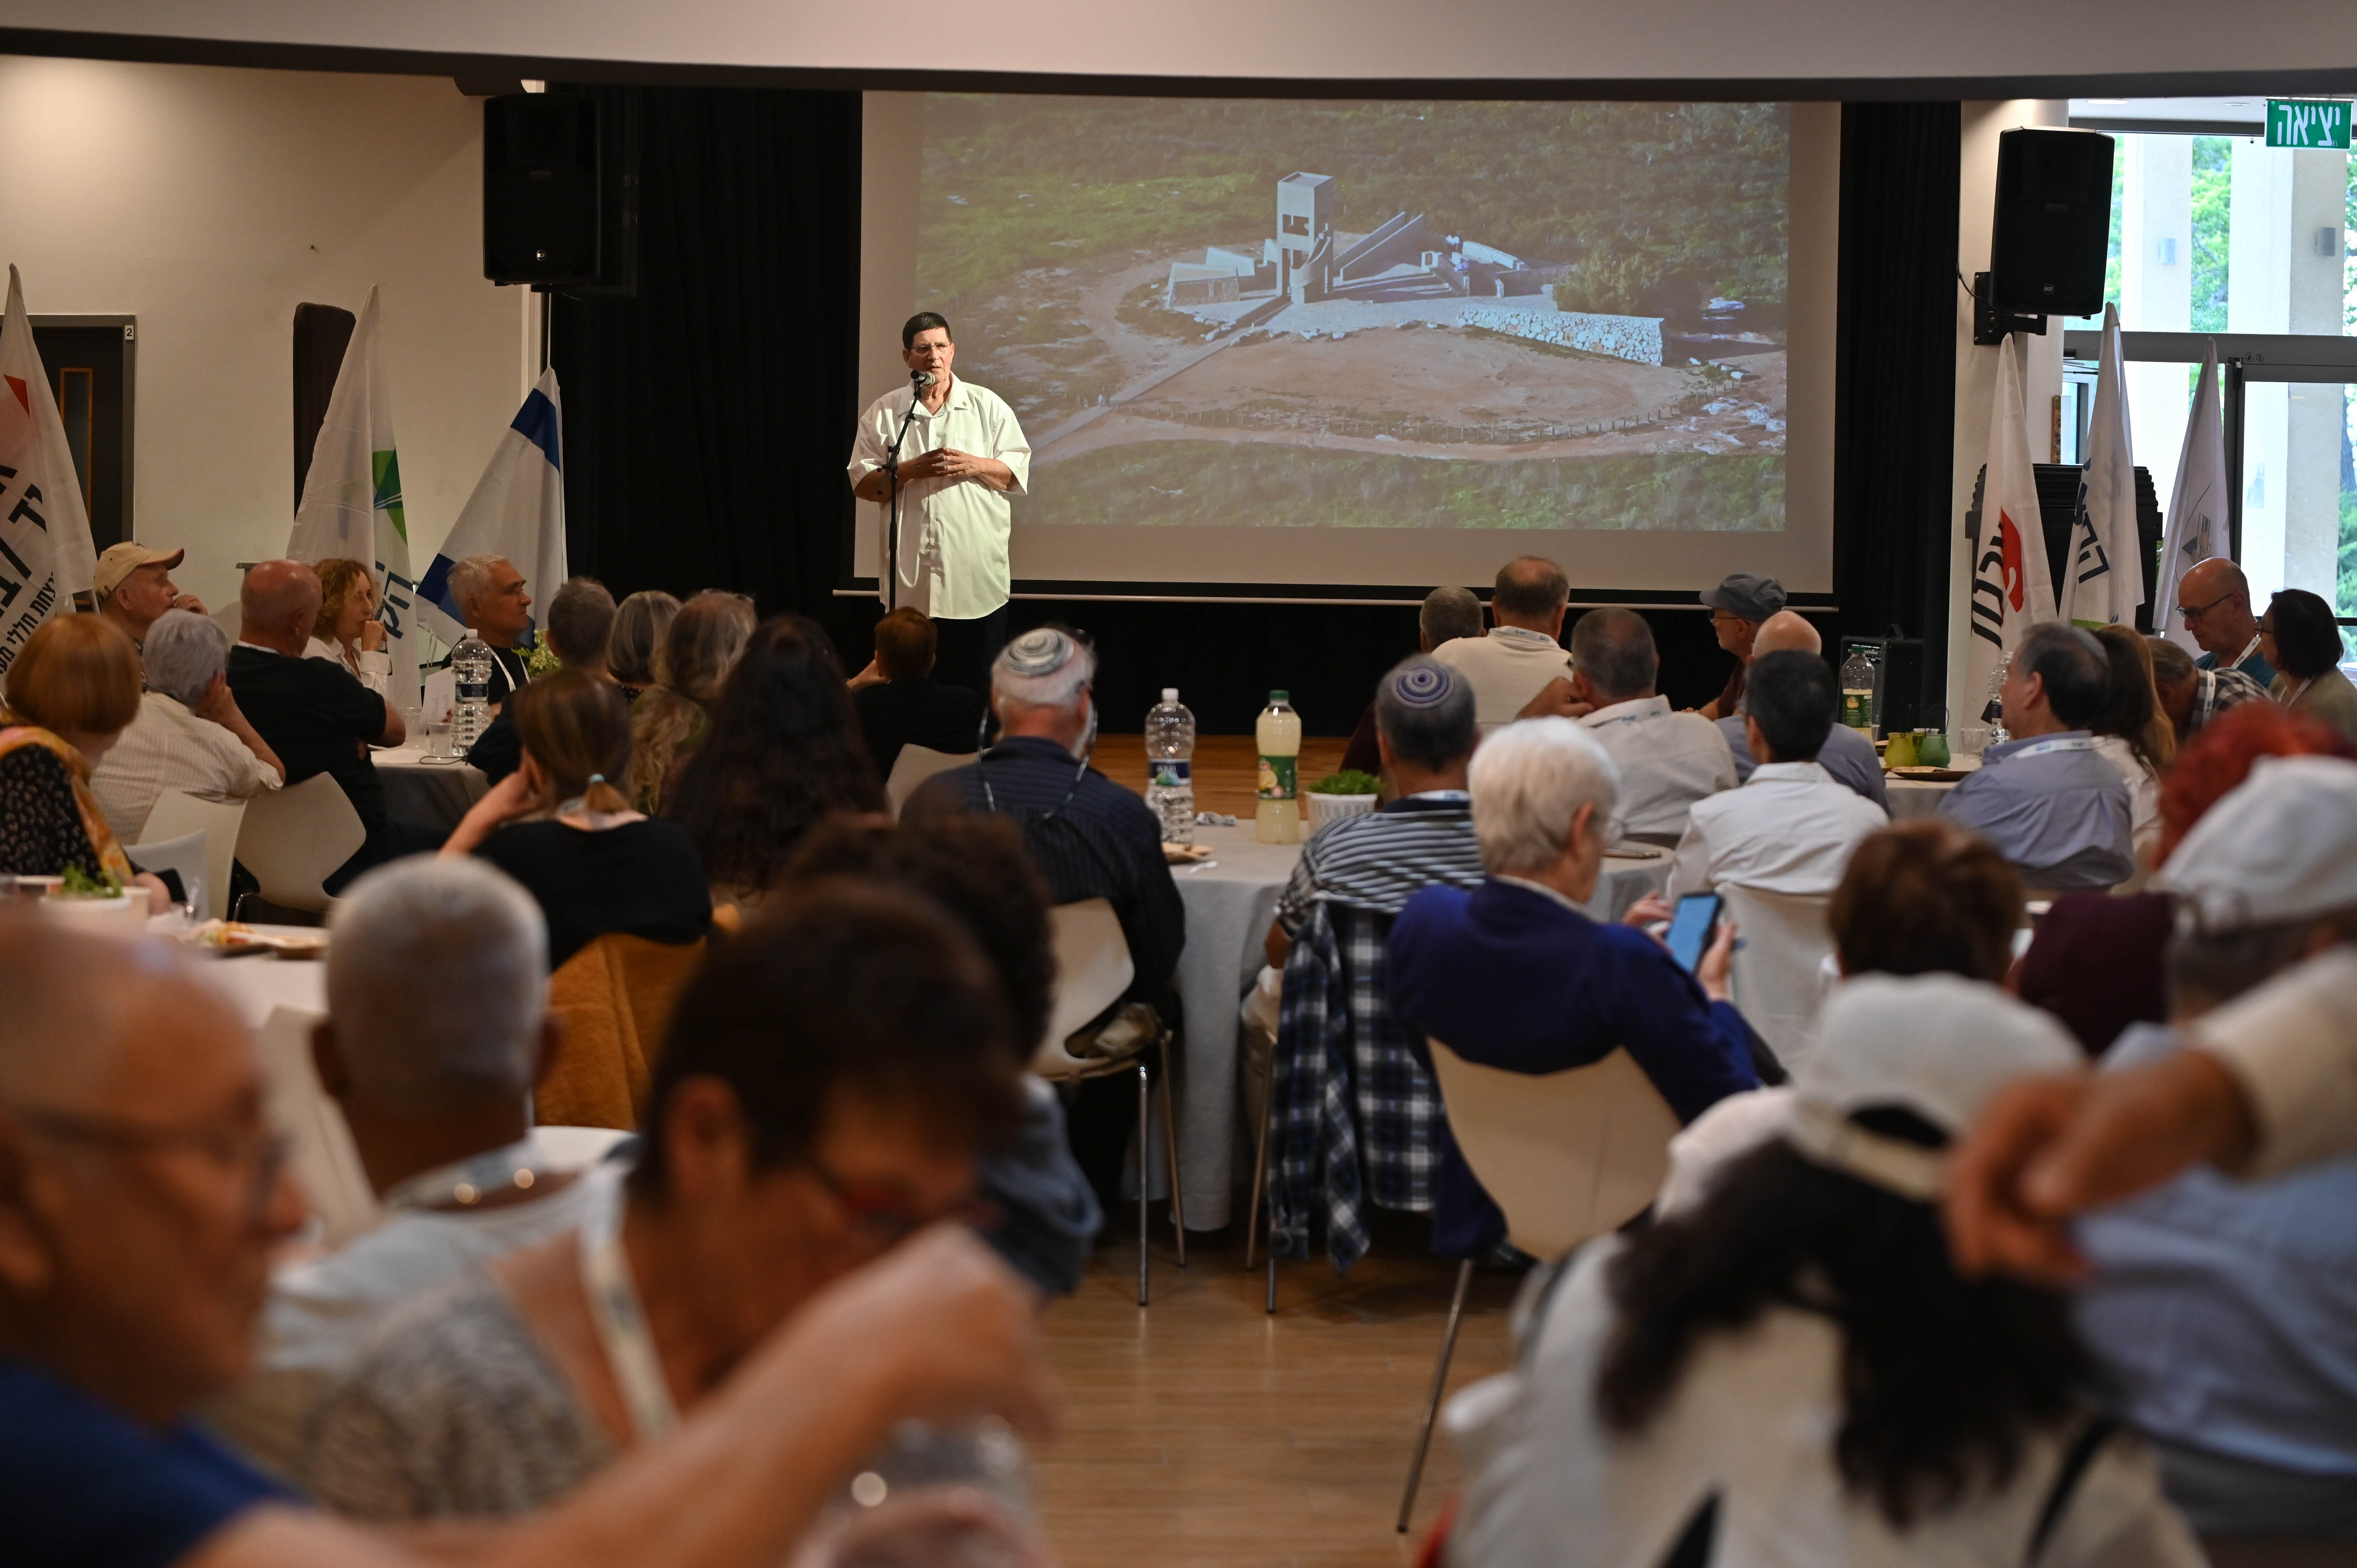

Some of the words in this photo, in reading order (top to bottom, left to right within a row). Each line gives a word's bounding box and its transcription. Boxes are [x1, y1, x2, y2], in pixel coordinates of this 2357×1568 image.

[2277, 104, 2340, 146] יציאה
[126, 328, 133, 337] 2
[7, 612, 39, 645] חללי
